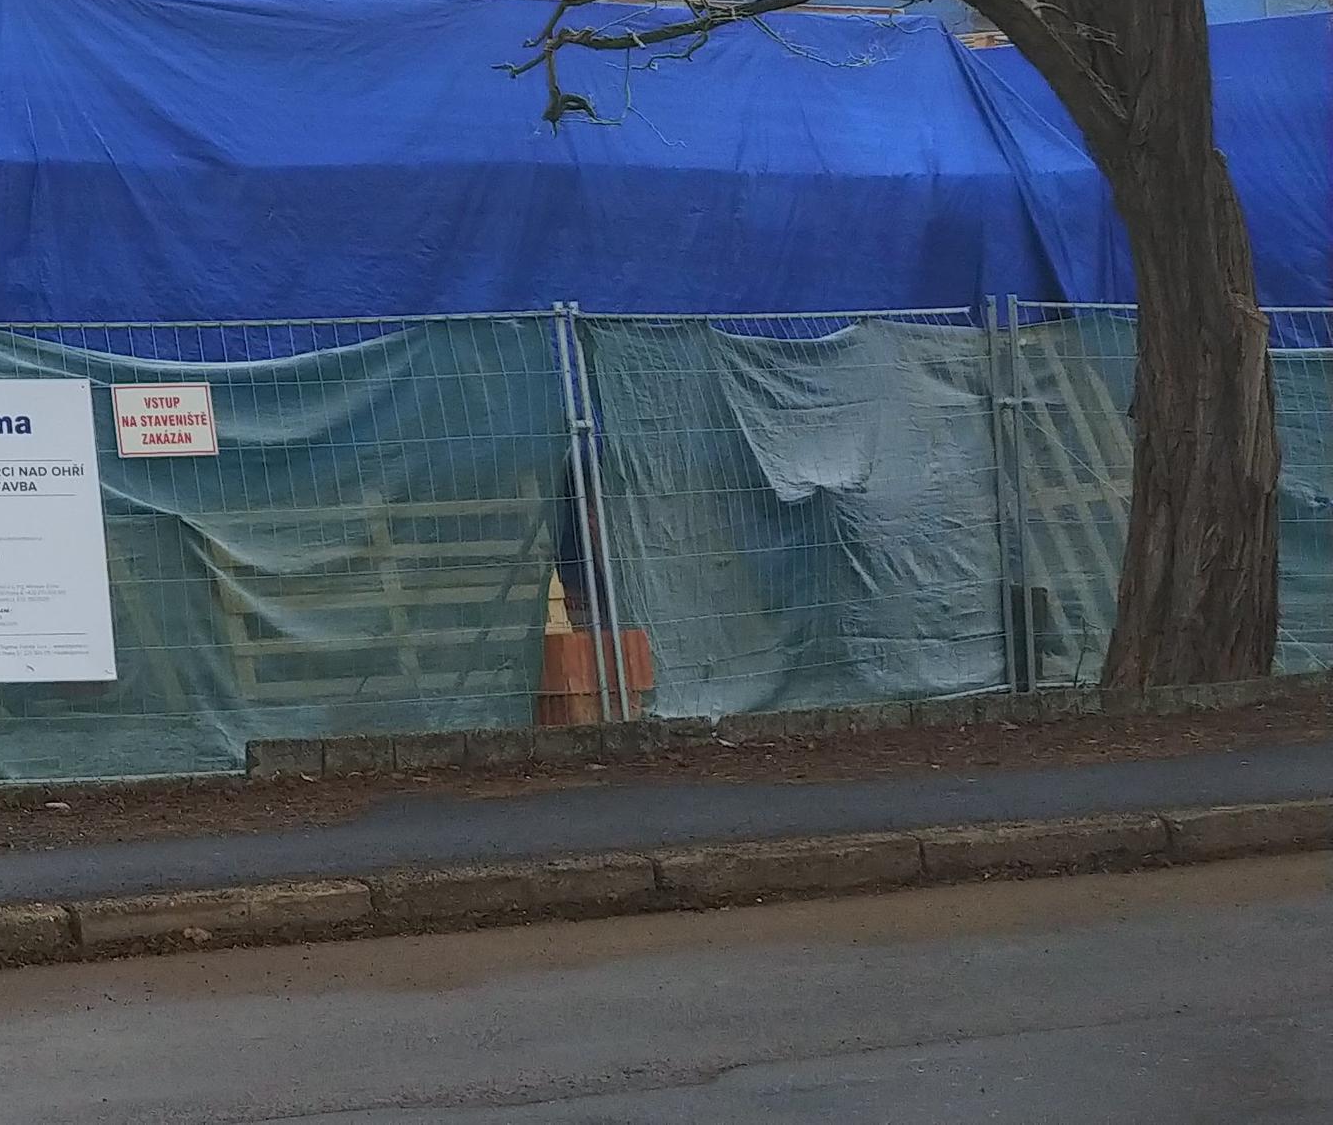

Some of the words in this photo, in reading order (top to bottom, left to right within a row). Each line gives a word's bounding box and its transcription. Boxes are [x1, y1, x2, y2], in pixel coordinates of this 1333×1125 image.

[144, 397, 180, 409] VSTUP
[121, 416, 138, 427] NA
[140, 412, 208, 427] STAVENIŠTĚ
[141, 429, 192, 445] ZAKÁZÁN
[19, 466, 47, 476] NAD
[51, 463, 85, 476] OHŘÍ
